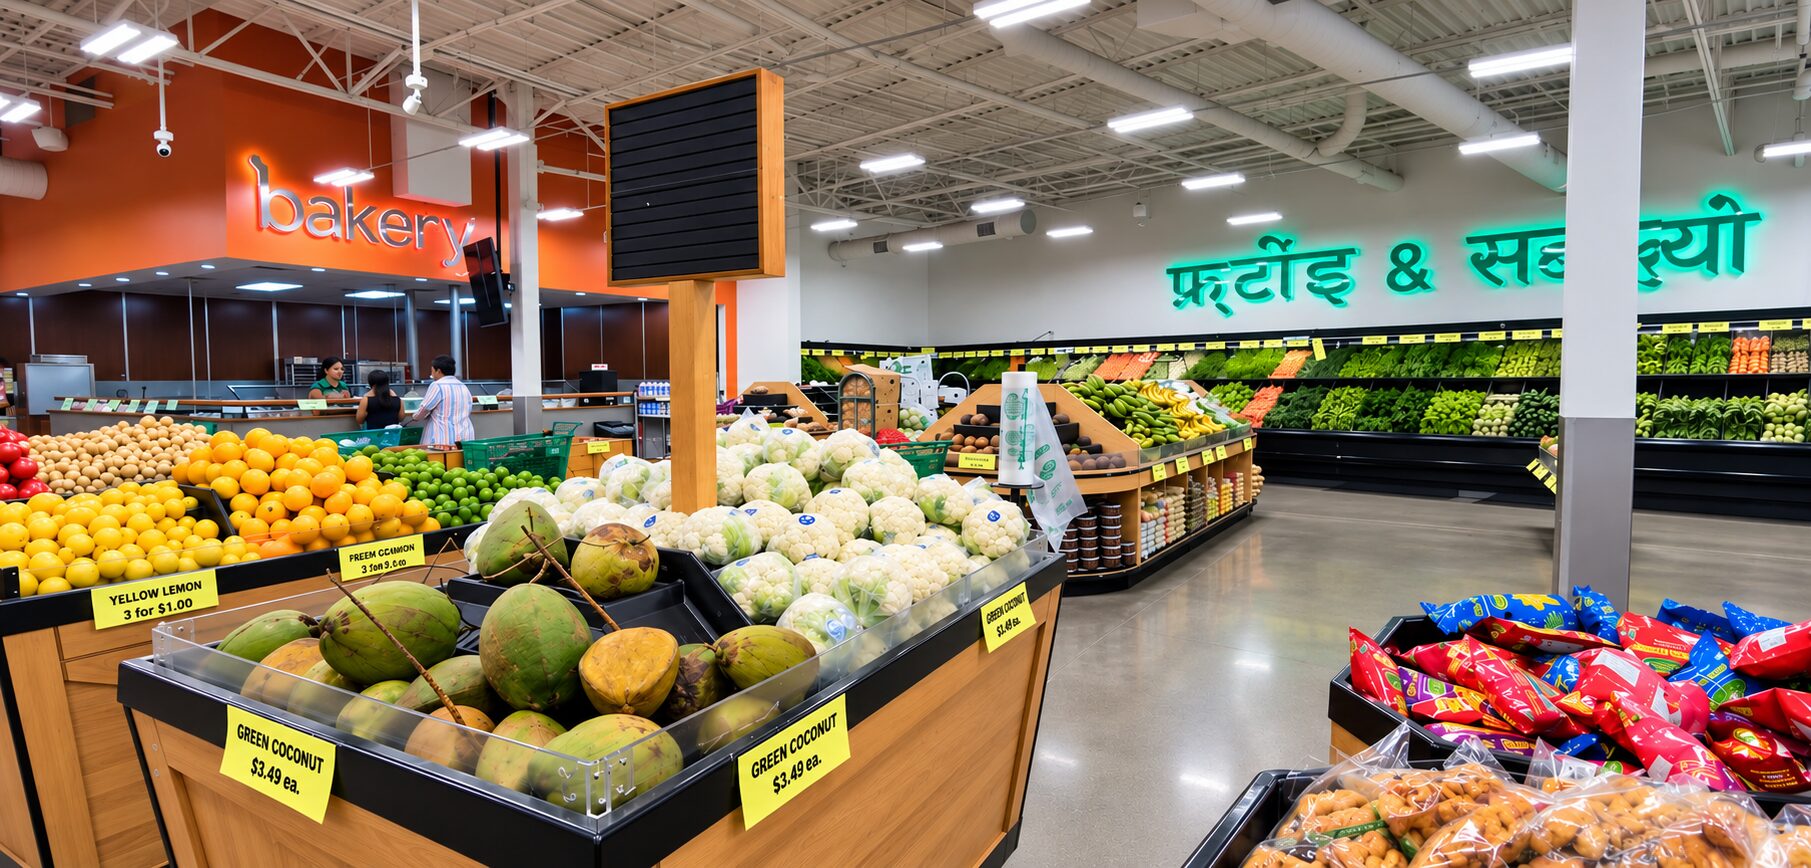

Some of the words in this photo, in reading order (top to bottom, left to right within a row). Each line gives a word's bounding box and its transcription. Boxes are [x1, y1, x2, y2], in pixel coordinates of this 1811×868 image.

[249, 155, 476, 267] bakery
[1386, 242, 1432, 292] &
[109, 588, 159, 606] YELLOW
[162, 580, 202, 596] LEMON
[123, 610, 132, 620] 3
[135, 607, 154, 618] for
[158, 598, 193, 615] $1.00
[237, 723, 270, 751] GREEN
[271, 739, 325, 774] COCONUT
[751, 743, 787, 779] GREEN
[789, 712, 838, 754] COCONUT
[250, 757, 282, 785] $3.49
[283, 776, 300, 795] ea.
[772, 759, 804, 795] $3.49
[805, 754, 822, 771] ea.
